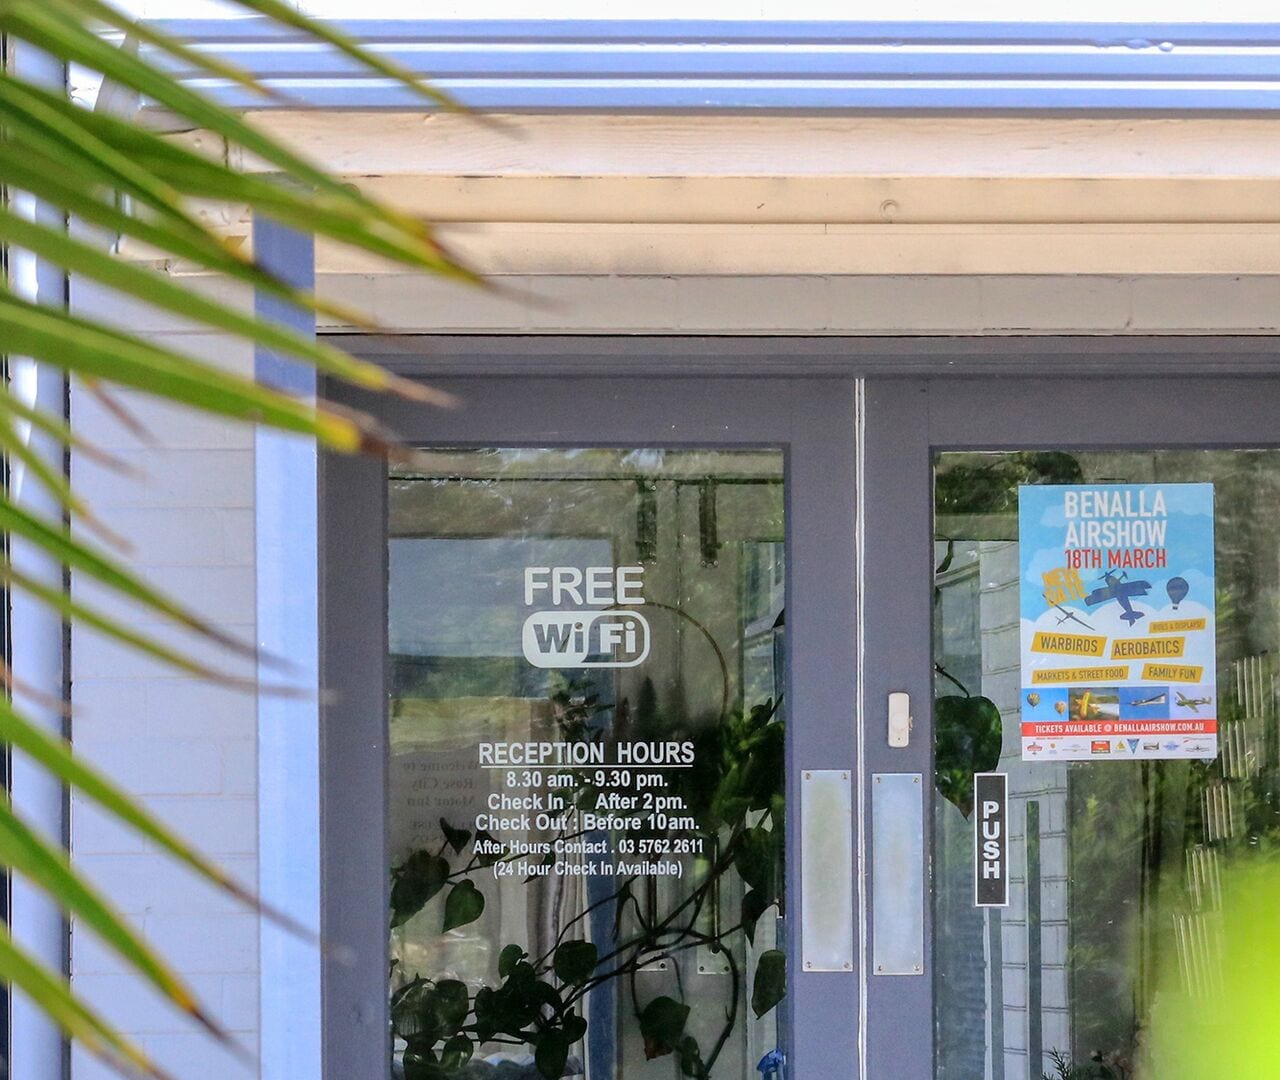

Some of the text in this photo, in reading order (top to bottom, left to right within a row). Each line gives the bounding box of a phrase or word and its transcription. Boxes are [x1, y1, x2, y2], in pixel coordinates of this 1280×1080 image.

[1064, 489, 1168, 518] BENALLA
[1064, 519, 1167, 548] AIRSHOW
[1064, 548, 1167, 569] 18TH MARCH
[524, 566, 646, 605] FREE
[1040, 636, 1099, 653] WARBIRDS
[1113, 640, 1180, 657] AEROBATICS
[1037, 672, 1070, 681] MARKETS
[1079, 670, 1104, 679] STREET
[1106, 668, 1124, 679] FOOD
[1148, 668, 1196, 679] FAMILY FUN
[1035, 725, 1063, 733] TICKETS
[1065, 724, 1102, 733] AVAILABLE
[1114, 722, 1205, 731] BENALLAAIRSHOW.COM.AU
[478, 742, 695, 765] RECEPTION HOURS
[506, 771, 542, 788] 8.30
[547, 775, 579, 788] am.
[595, 771, 631, 788] 9.30
[636, 775, 668, 791] pm.
[487, 794, 544, 810] Check
[549, 794, 564, 809] In
[595, 793, 638, 809] After
[475, 814, 531, 831] Check
[536, 814, 568, 830] Out
[584, 814, 641, 830] Before
[473, 839, 507, 854] After
[510, 840, 550, 855] Hours
[554, 840, 607, 854] Contact
[619, 839, 635, 854] 03
[638, 839, 671, 854] 5762
[673, 839, 703, 854] 2611
[982, 801, 1001, 879] PUSH
[493, 860, 682, 880] (24 Hour Check In Available)
